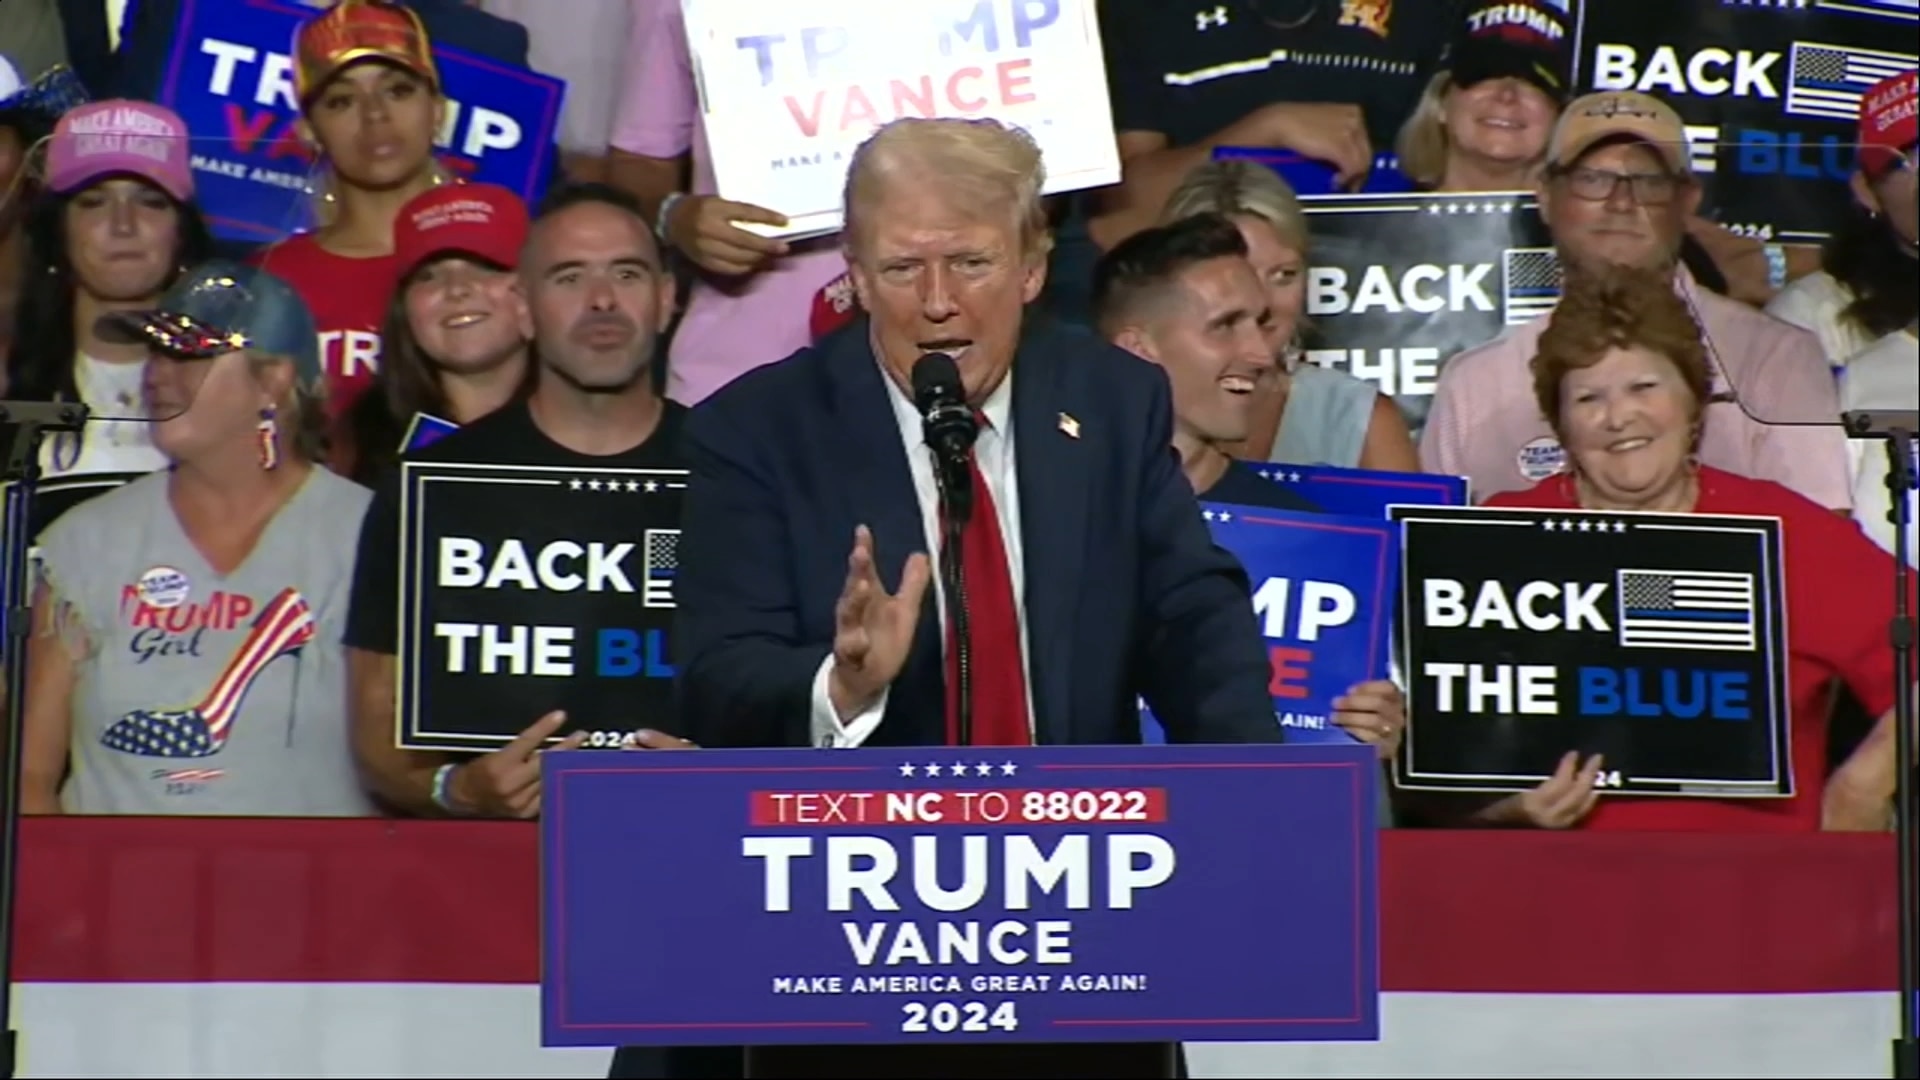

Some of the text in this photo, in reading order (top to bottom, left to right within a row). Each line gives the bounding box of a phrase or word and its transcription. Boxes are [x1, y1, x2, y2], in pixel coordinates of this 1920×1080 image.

[1467, 3, 1564, 39] TRUMP
[1593, 43, 1782, 98] BACK
[783, 58, 1037, 138] VANCE
[191, 156, 246, 178] MAKE
[1739, 130, 1852, 180] BLU
[1307, 264, 1495, 316] BACK
[1306, 348, 1439, 396] THE
[439, 536, 635, 592] BACK
[1423, 579, 1611, 632] BACK
[130, 626, 207, 665] Girl
[434, 623, 678, 677] THE BL
[1424, 662, 1752, 720] THE BLUE
[771, 790, 1147, 823] TEXT NC TO 88022
[742, 833, 1176, 912] TRUMP
[842, 919, 1072, 966] VANCE
[772, 974, 1147, 994] MAKE AMERICA GREAT AGAIN!
[901, 1001, 1018, 1032] 2024
